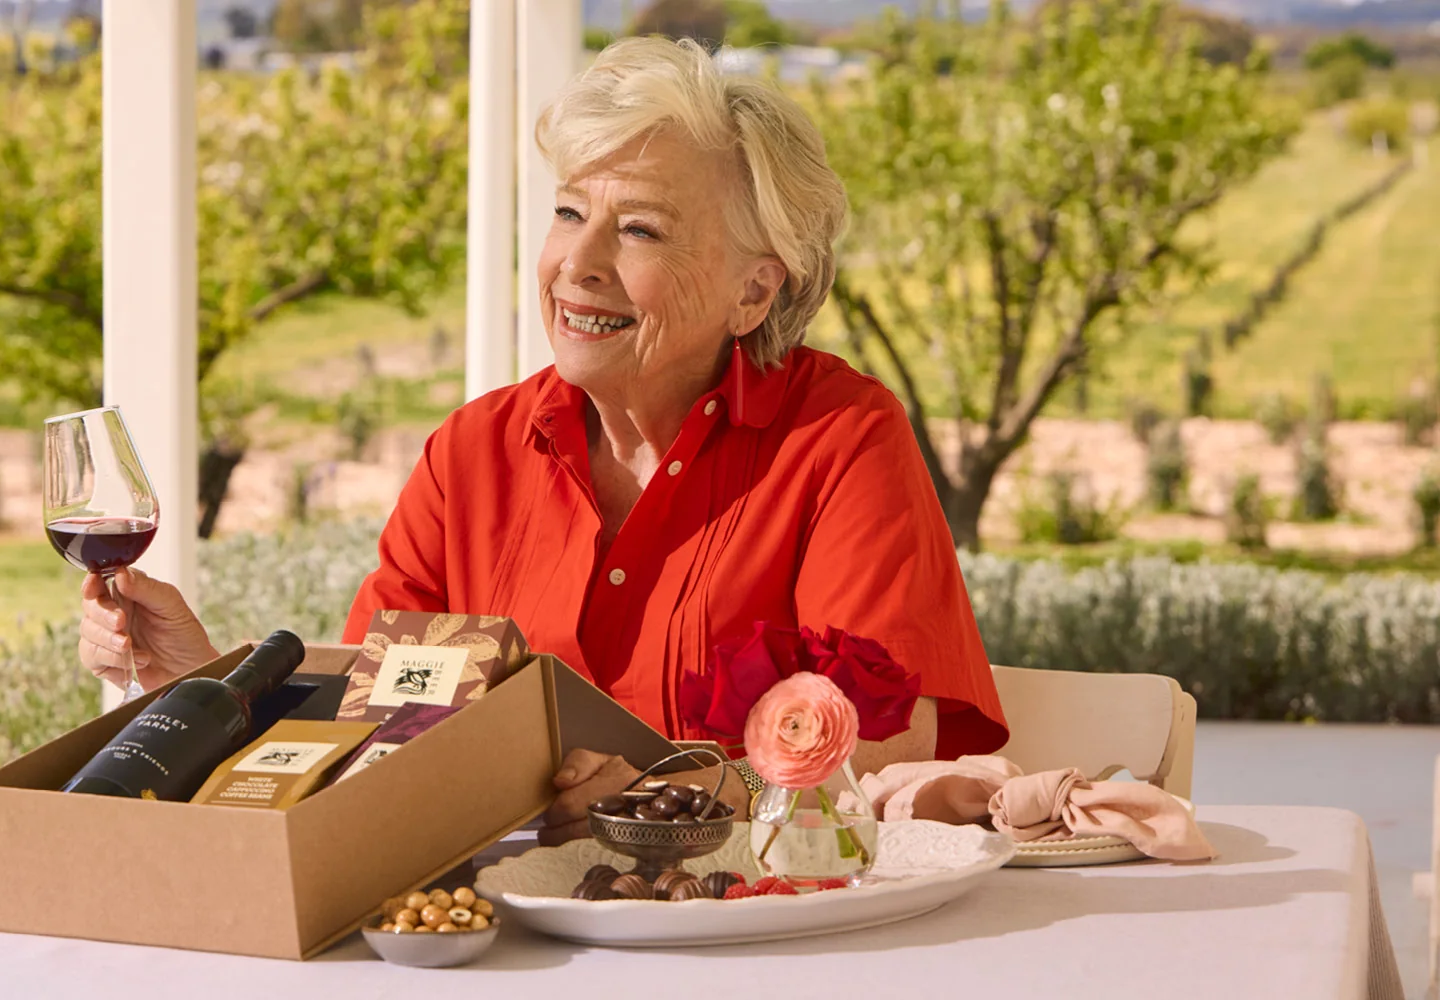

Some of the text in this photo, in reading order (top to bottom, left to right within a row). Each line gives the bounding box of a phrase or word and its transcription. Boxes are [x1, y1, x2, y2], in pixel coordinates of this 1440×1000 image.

[400, 659, 446, 669] MAGGIE
[137, 720, 171, 732] FARM
[232, 781, 279, 789] CHOCOLATE
[219, 791, 249, 799] COFFEE
